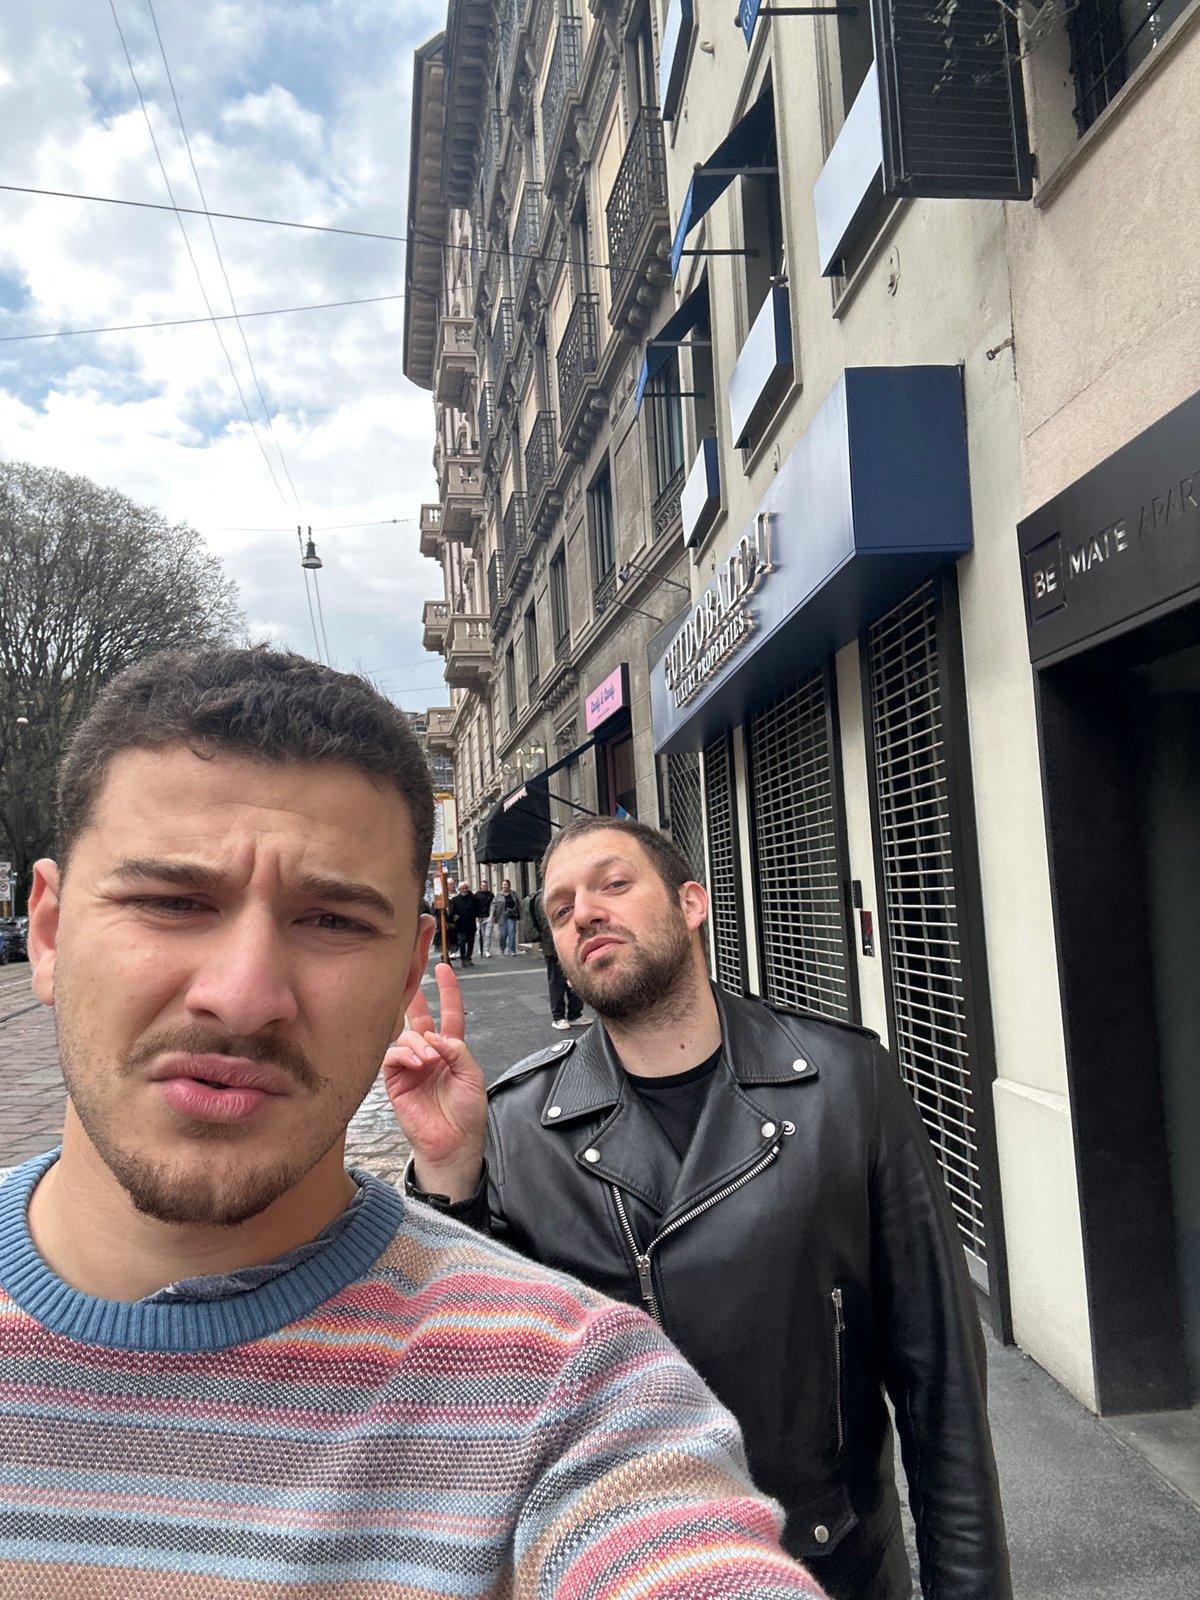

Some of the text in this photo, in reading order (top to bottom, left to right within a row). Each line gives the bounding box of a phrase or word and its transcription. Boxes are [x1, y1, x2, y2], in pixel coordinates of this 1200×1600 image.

[1033, 470, 1200, 599] BE MATE APAR
[664, 511, 766, 691] GUIDOBALDI
[674, 609, 745, 708] LUXURY PROPERTIES
